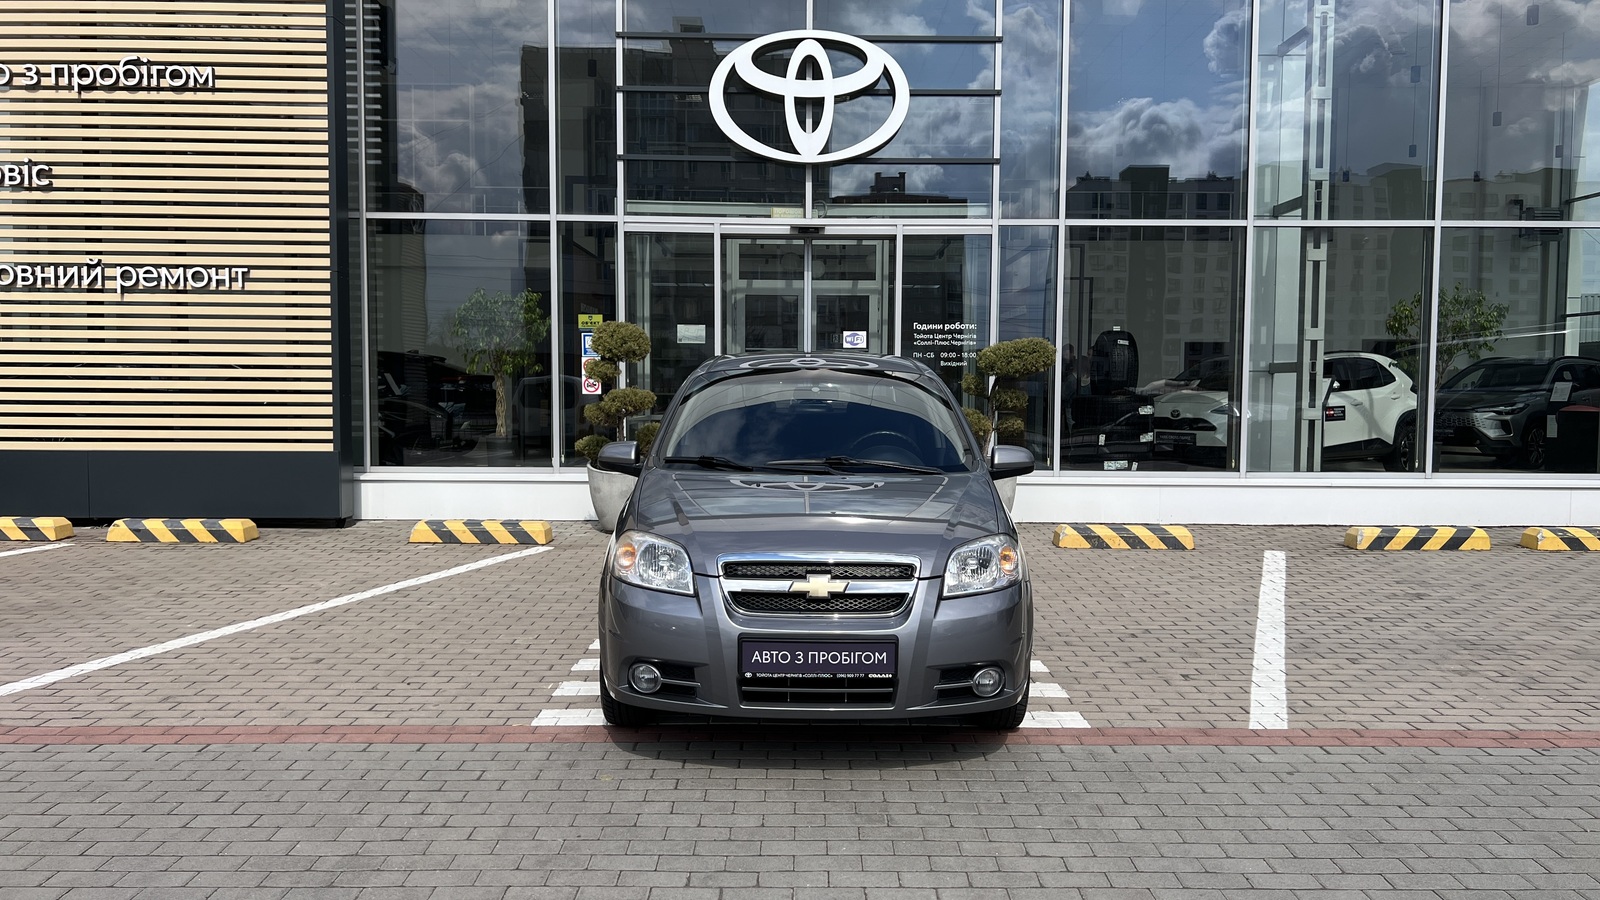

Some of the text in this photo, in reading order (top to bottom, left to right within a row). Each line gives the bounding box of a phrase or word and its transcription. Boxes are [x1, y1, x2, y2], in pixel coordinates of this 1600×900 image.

[22, 63, 39, 85] з
[50, 56, 214, 92] пробігом
[0, 157, 50, 186] віс
[116, 264, 248, 294] ремонт
[913, 321, 977, 332] Години роботи:
[934, 332, 953, 340] Центр
[952, 332, 977, 340] Чернігів
[751, 650, 887, 665] АВТО З ПРОБІГОМ
